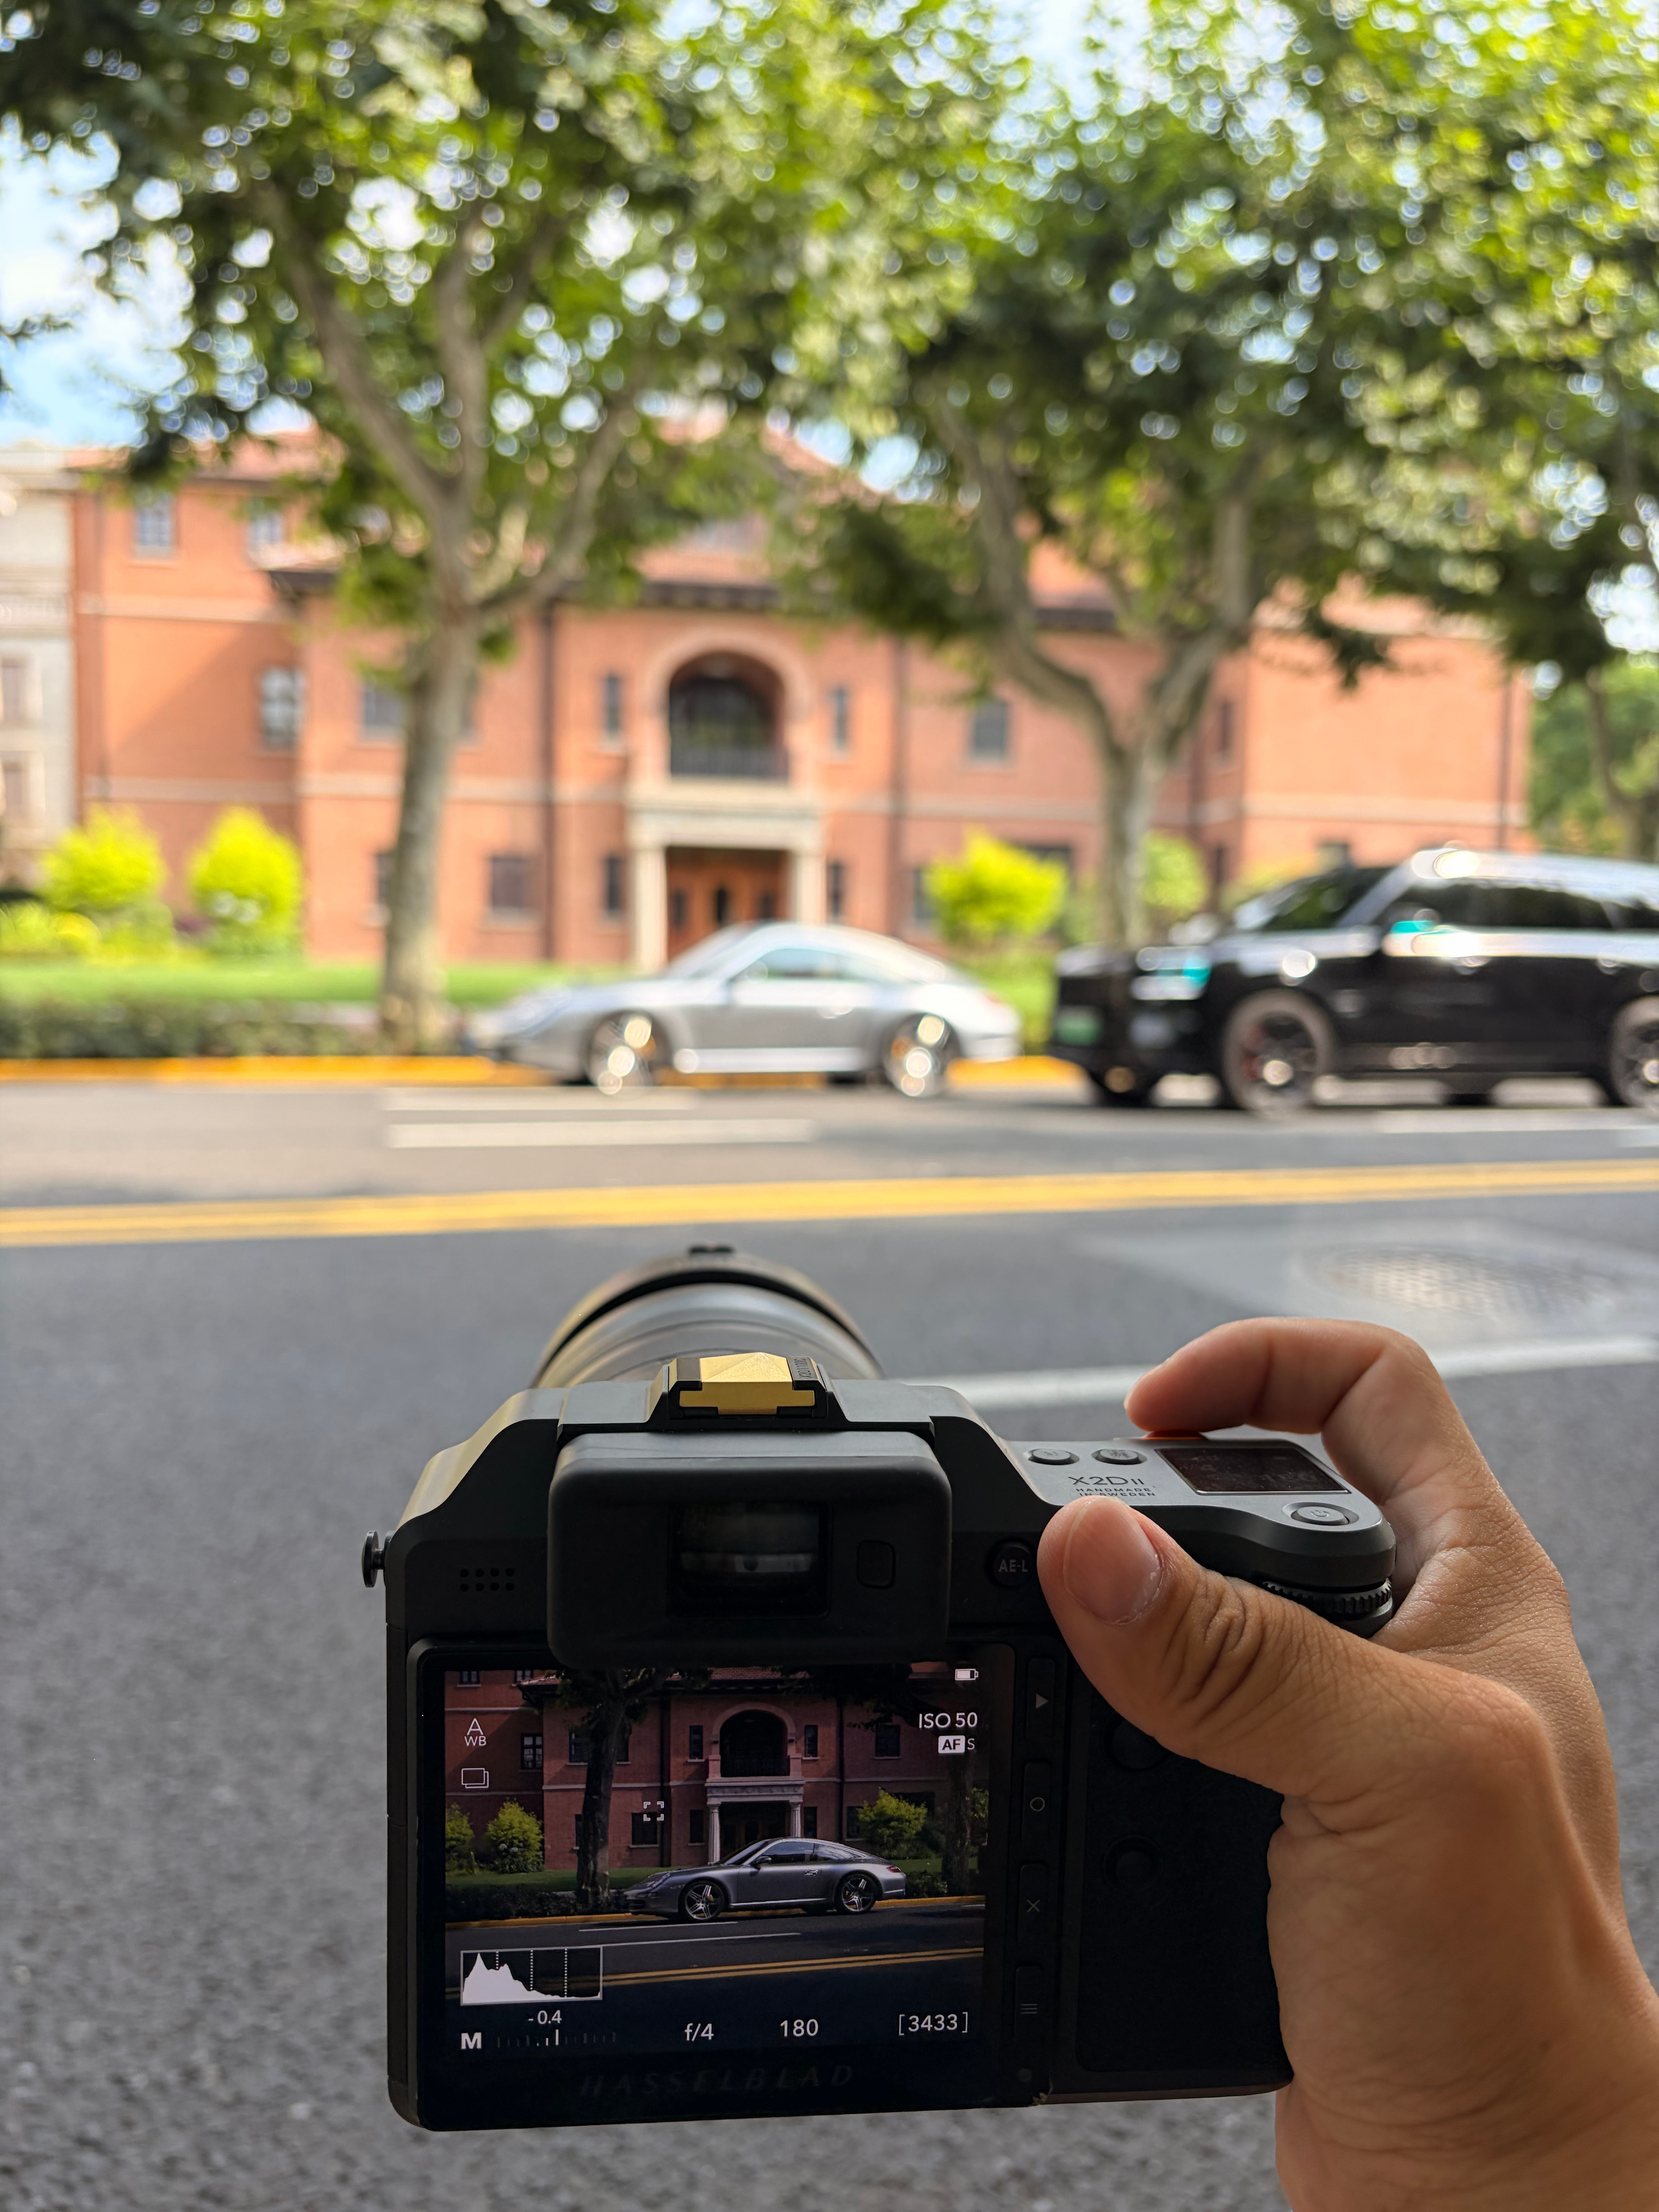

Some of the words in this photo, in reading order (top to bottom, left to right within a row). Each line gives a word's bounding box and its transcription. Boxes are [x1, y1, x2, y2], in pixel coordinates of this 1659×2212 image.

[1067, 1477, 1128, 1485] X2D
[998, 1559, 1028, 1572] AE-L
[467, 1718, 484, 1735] A
[919, 1713, 951, 1729] ISO
[955, 1712, 978, 1728] 50
[464, 1736, 486, 1746] WB
[942, 1739, 961, 1750] AF
[967, 1738, 975, 1750] S
[461, 2032, 482, 2049] M
[684, 2023, 714, 2041] f/4
[780, 2019, 819, 2037] 180
[899, 2012, 969, 2036] [3433]
[580, 2064, 854, 2097] HASSELBLAD
